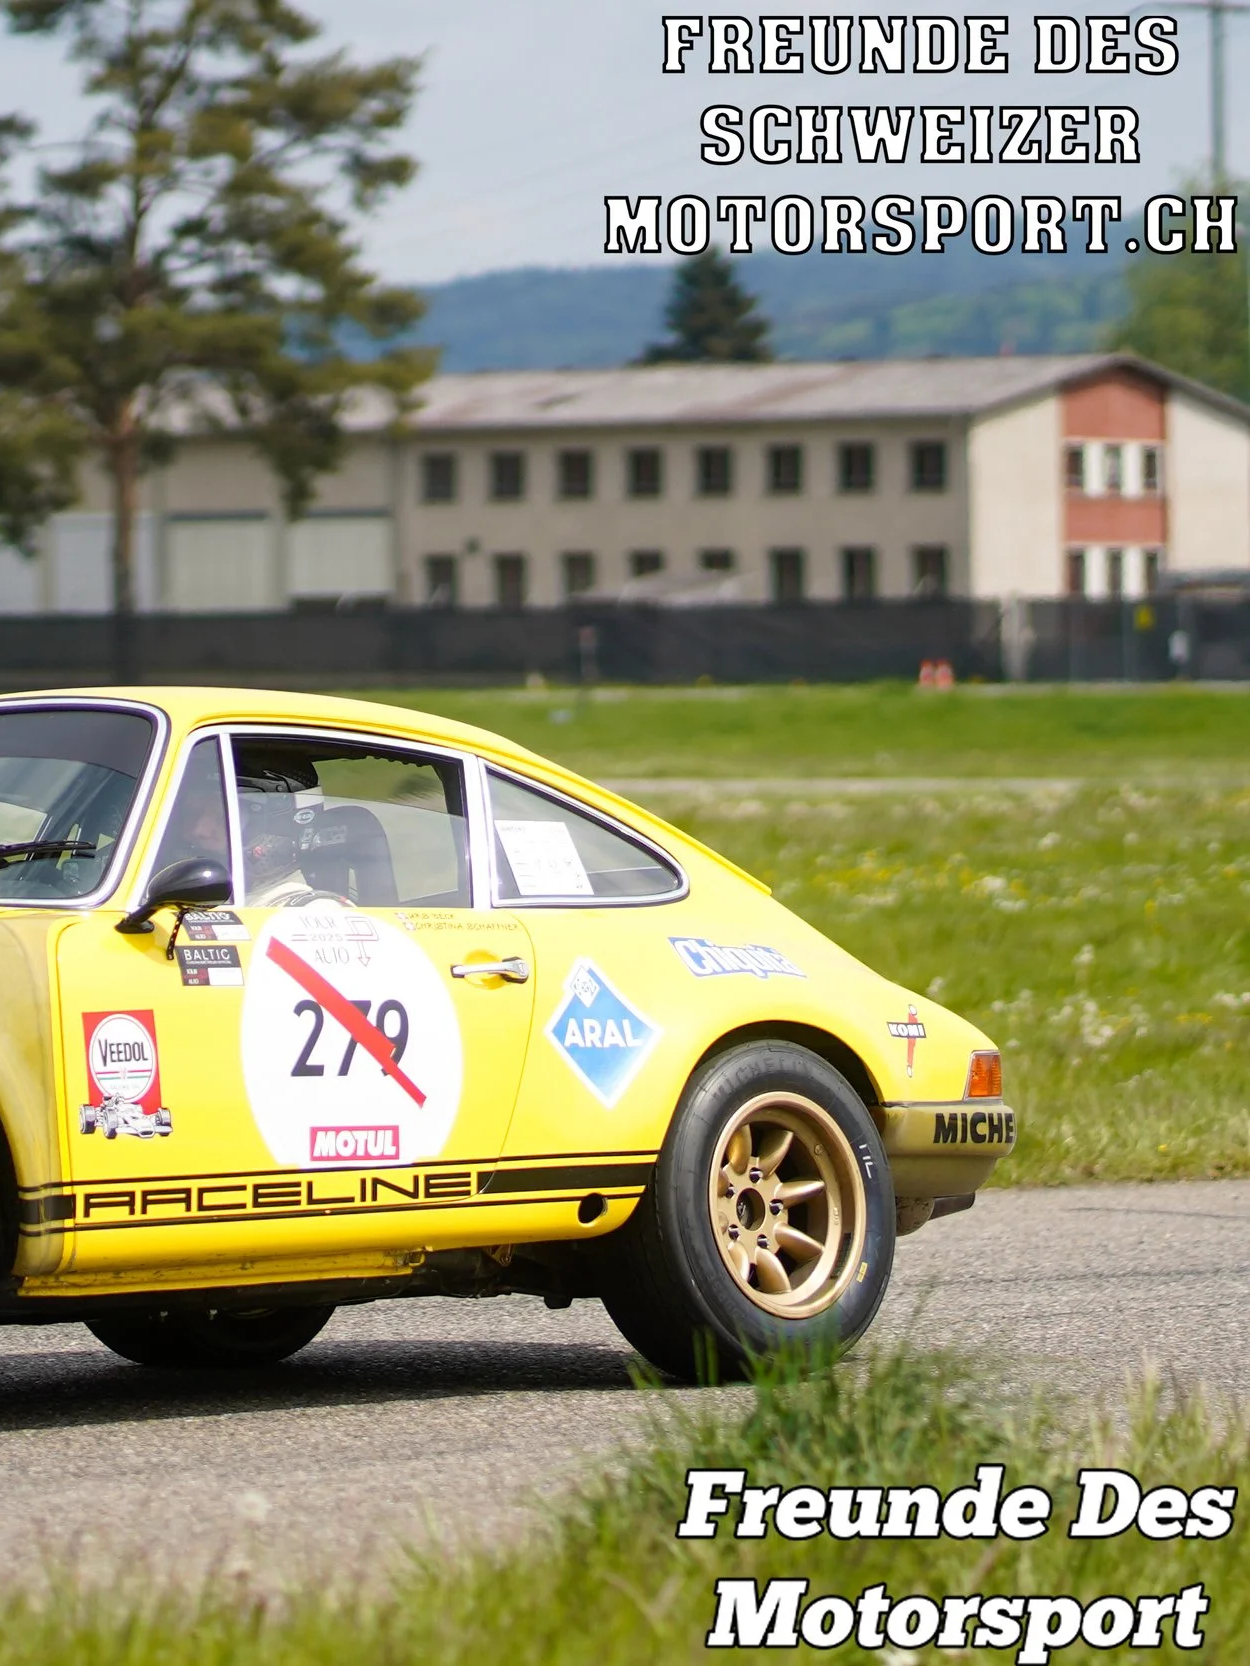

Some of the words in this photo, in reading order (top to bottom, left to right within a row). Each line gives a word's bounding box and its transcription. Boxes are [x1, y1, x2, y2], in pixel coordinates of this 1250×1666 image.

[184, 948, 230, 960] BALTIC
[674, 938, 806, 978] Chiquita
[290, 999, 409, 1077] 279
[564, 1017, 643, 1048] ARAL
[888, 1023, 925, 1036] KONI
[98, 1038, 148, 1067] VEEDOL
[312, 1129, 397, 1157] MOTUL
[83, 1172, 471, 1219] RACELINE
